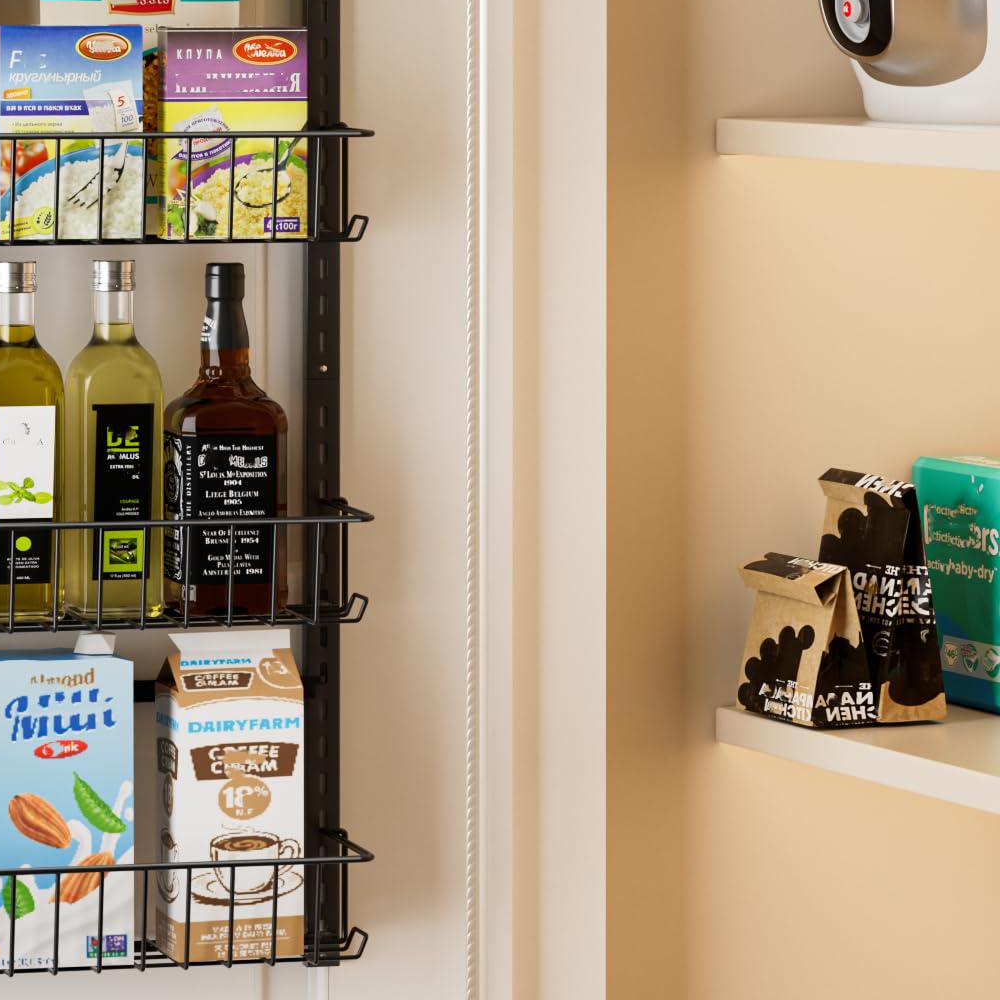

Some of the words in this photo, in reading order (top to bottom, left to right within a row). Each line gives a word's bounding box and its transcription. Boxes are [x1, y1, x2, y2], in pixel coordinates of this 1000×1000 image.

[117, 96, 126, 108] 5
[121, 114, 134, 124] 100
[187, 717, 300, 734] DAIRYFARM
